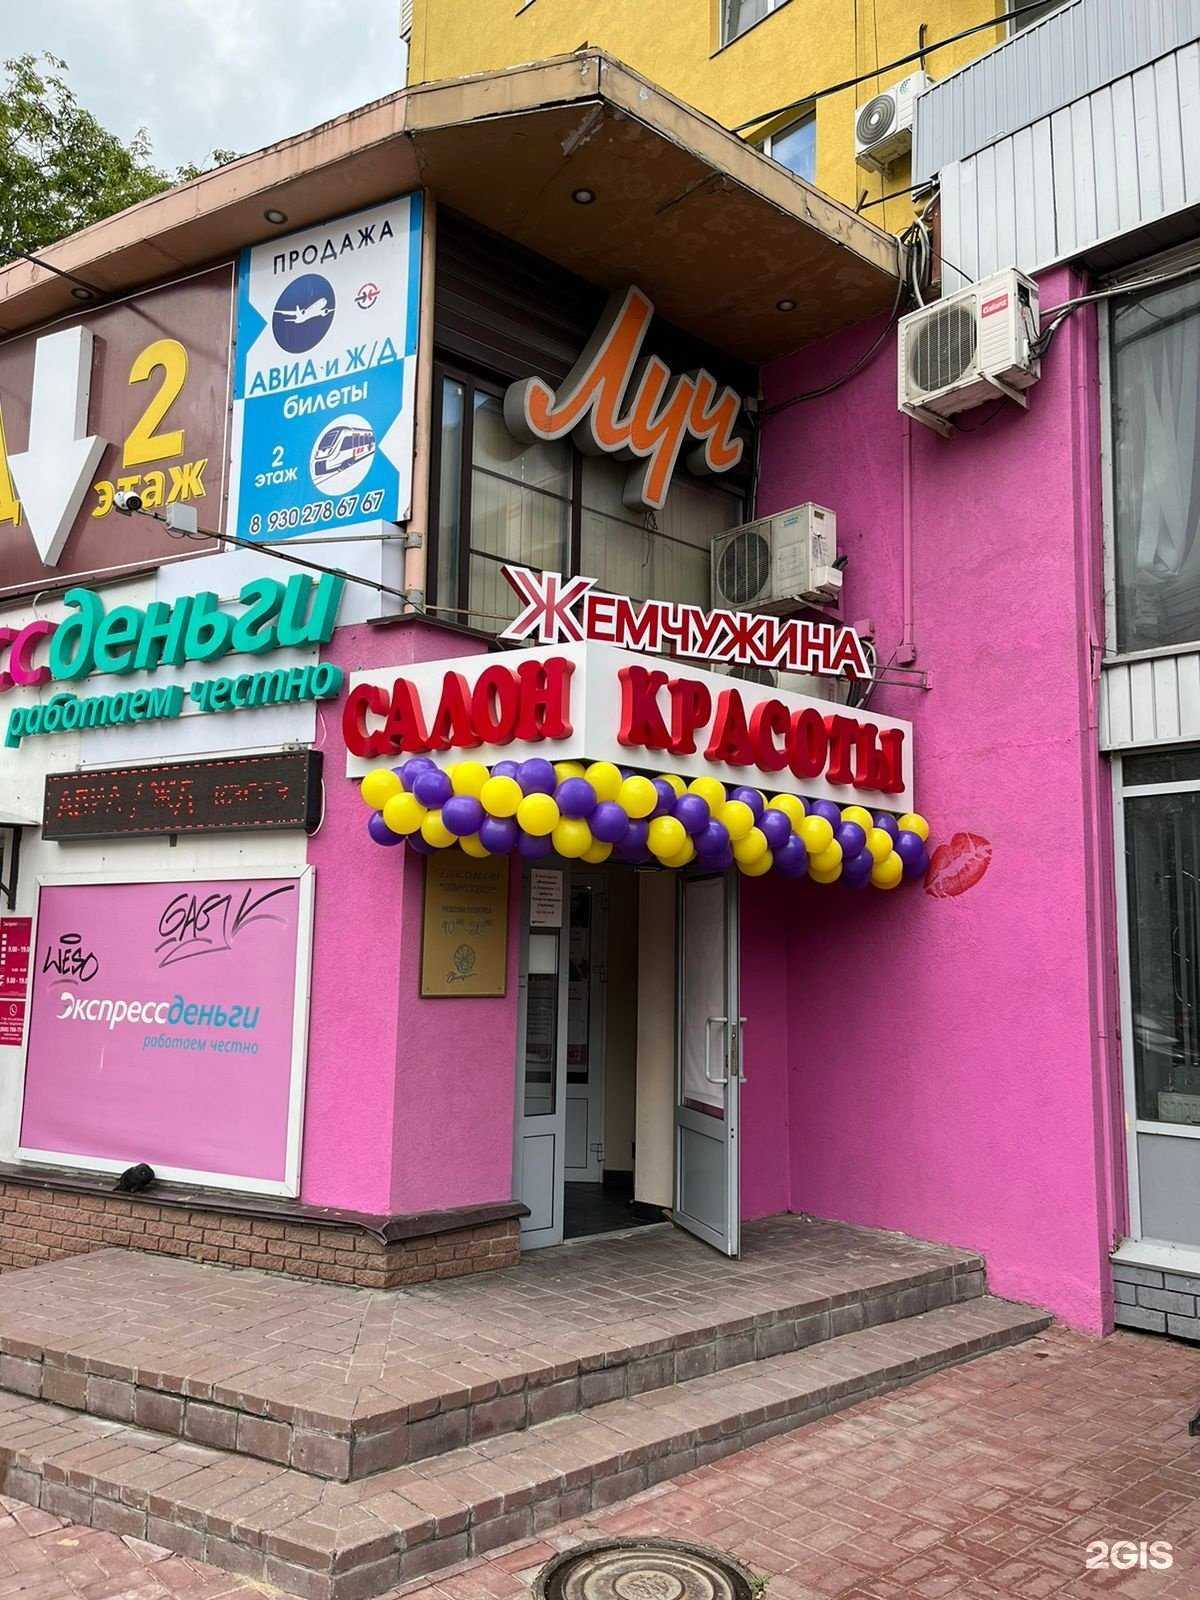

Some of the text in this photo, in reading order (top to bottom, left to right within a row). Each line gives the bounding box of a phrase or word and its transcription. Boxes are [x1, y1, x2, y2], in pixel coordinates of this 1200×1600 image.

[273, 219, 394, 275] ПРОДАЖА
[250, 337, 397, 395] АВИА и Ж/Д
[123, 338, 189, 469] 2
[283, 380, 369, 420] билеты
[507, 284, 744, 511] Луч
[254, 467, 298, 488] этаж
[271, 446, 285, 468] 2
[250, 489, 385, 535] 8 930 278 67 67
[5, 662, 345, 749] работаем честно
[342, 656, 906, 794] САЛОН КРАСОТЫ
[142, 1033, 259, 1055] работаем честно
